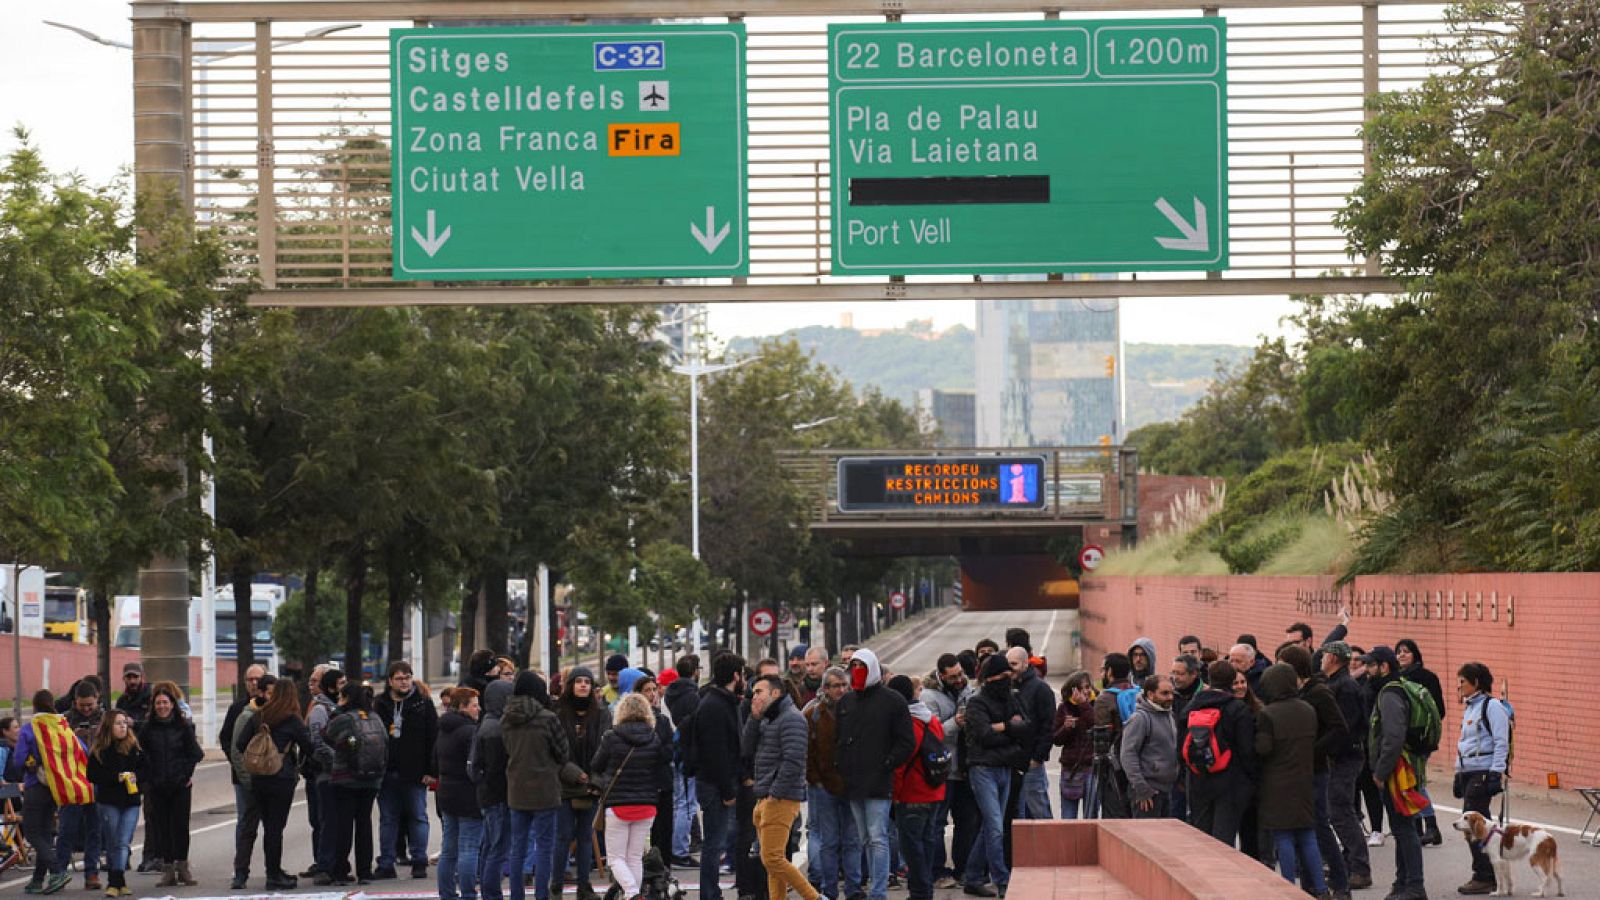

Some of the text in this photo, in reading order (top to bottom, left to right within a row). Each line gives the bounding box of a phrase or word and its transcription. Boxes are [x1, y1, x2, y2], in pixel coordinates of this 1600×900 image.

[409, 46, 509, 78] Sitges
[599, 46, 660, 66] C-32
[847, 41, 1078, 69] 22 Barceloneta
[1105, 37, 1209, 65] 1.200m
[409, 85, 625, 112] Castelldefels
[847, 104, 1038, 131] Pla de Palau
[410, 126, 598, 153] Zona Franca
[614, 128, 674, 151] Fira
[849, 137, 1039, 164] Via Laietana
[410, 166, 585, 193] Ciutat Vella
[848, 218, 951, 245] Port Vell
[904, 464, 979, 476] RECORDEU
[885, 478, 998, 490] RESTRICCIONS
[914, 492, 980, 504] CAMIONS
